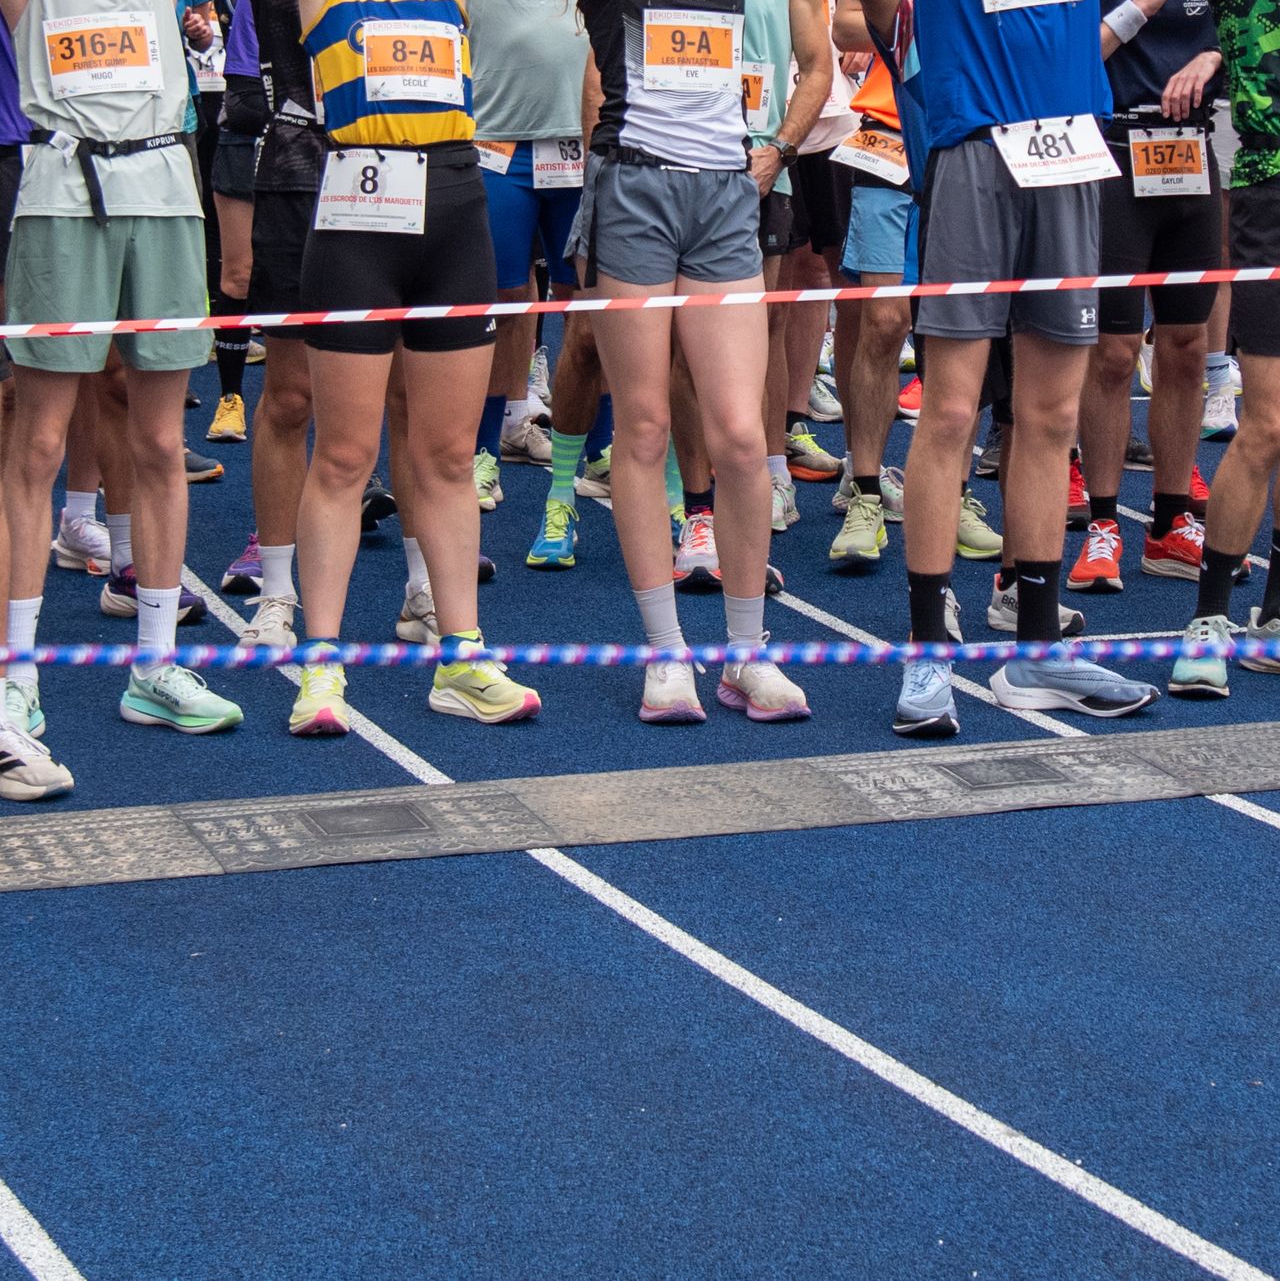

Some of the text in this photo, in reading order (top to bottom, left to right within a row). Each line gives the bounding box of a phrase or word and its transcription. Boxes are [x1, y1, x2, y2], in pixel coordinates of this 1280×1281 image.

[59, 31, 136, 60] 316-A
[671, 30, 711, 54] 9-A
[150, 40, 159, 62] 316-A
[392, 40, 435, 63] 8-A
[662, 57, 675, 65] LES
[91, 72, 112, 80] HUGO
[403, 78, 428, 87] CÉCILE
[686, 70, 699, 78] EVE
[753, 77, 761, 85] M
[146, 134, 176, 148] KIPRUN
[1027, 132, 1077, 160] 481
[1141, 144, 1196, 165] 157-A
[360, 165, 379, 194] 8
[331, 195, 357, 203] ESCROCS
[385, 198, 423, 206] MARQUETTE
